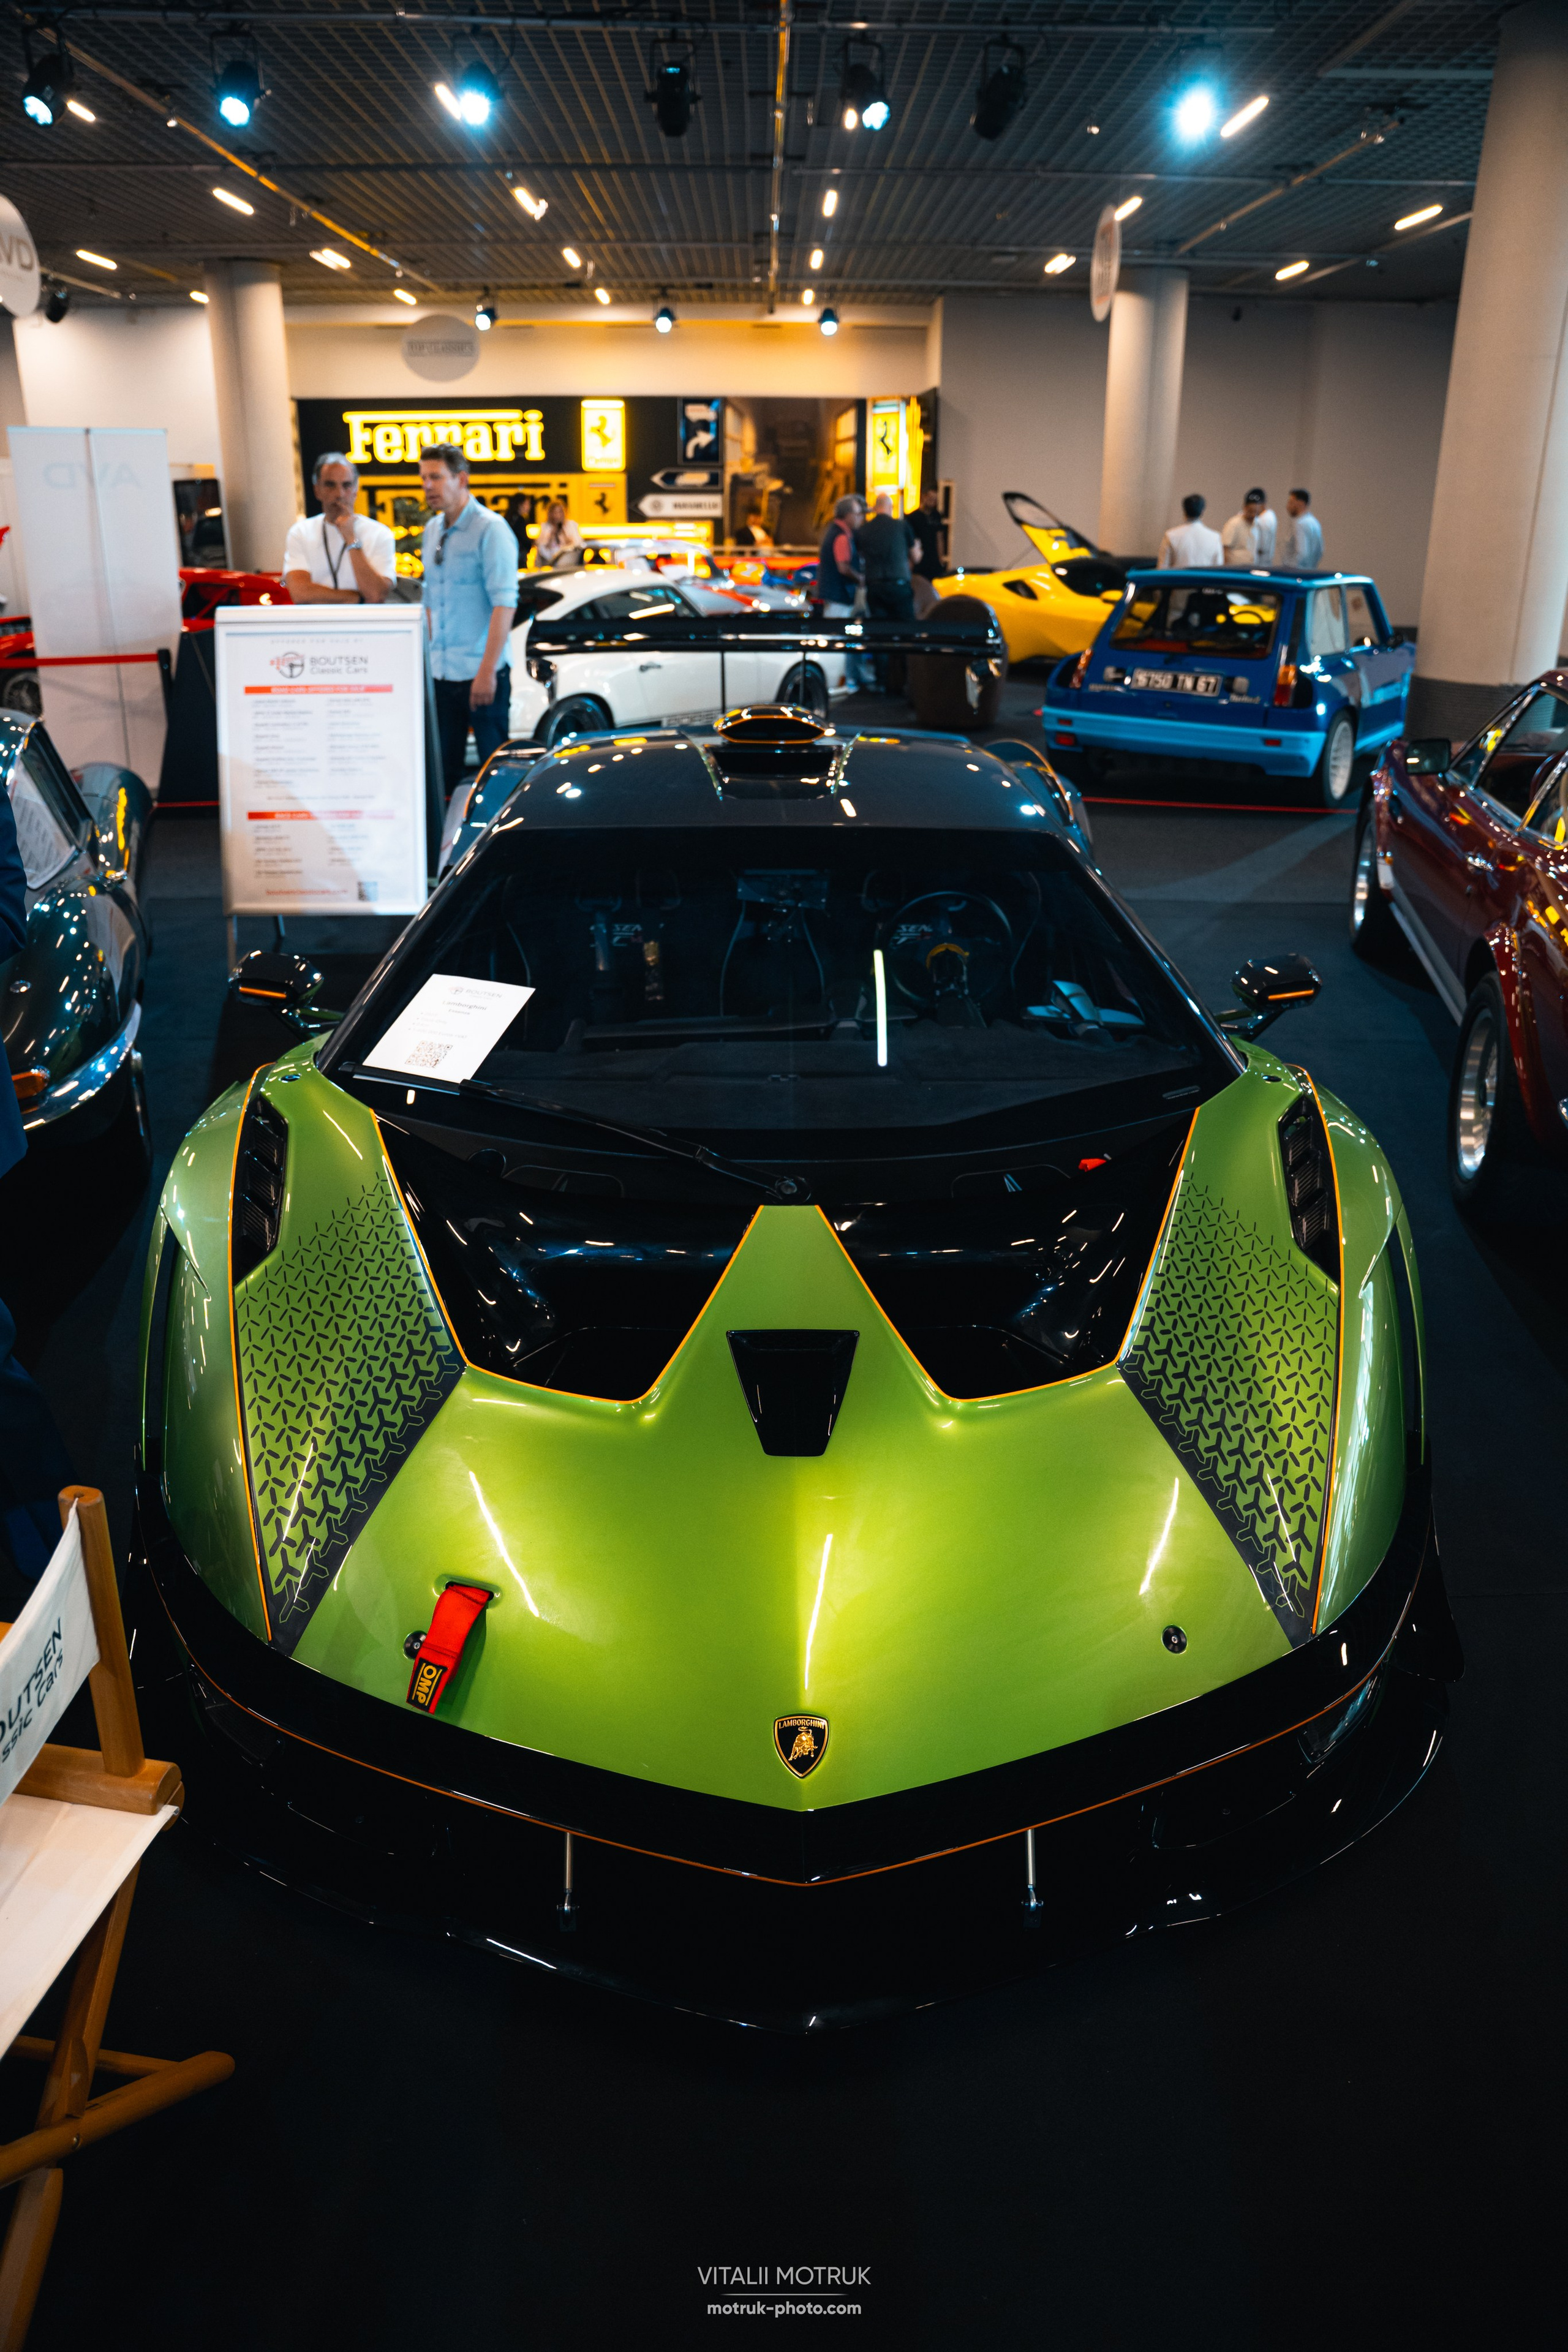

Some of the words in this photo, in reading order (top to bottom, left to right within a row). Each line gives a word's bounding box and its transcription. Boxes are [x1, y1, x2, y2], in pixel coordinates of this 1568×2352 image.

[0, 232, 35, 271] VD
[342, 409, 545, 464] Ferrari
[309, 655, 368, 666] BOUTSEN
[309, 666, 342, 675] Classic
[345, 666, 368, 674] Cars
[442, 1000, 488, 1011] Lamborghini
[465, 989, 503, 998] BOUTSEN
[0, 1616, 62, 1743] UTSEN
[416, 1664, 437, 1705] OMP
[0, 1708, 32, 1764] ssic
[37, 1648, 63, 1708] Cars
[778, 1719, 824, 1730] LAMBORGHINI
